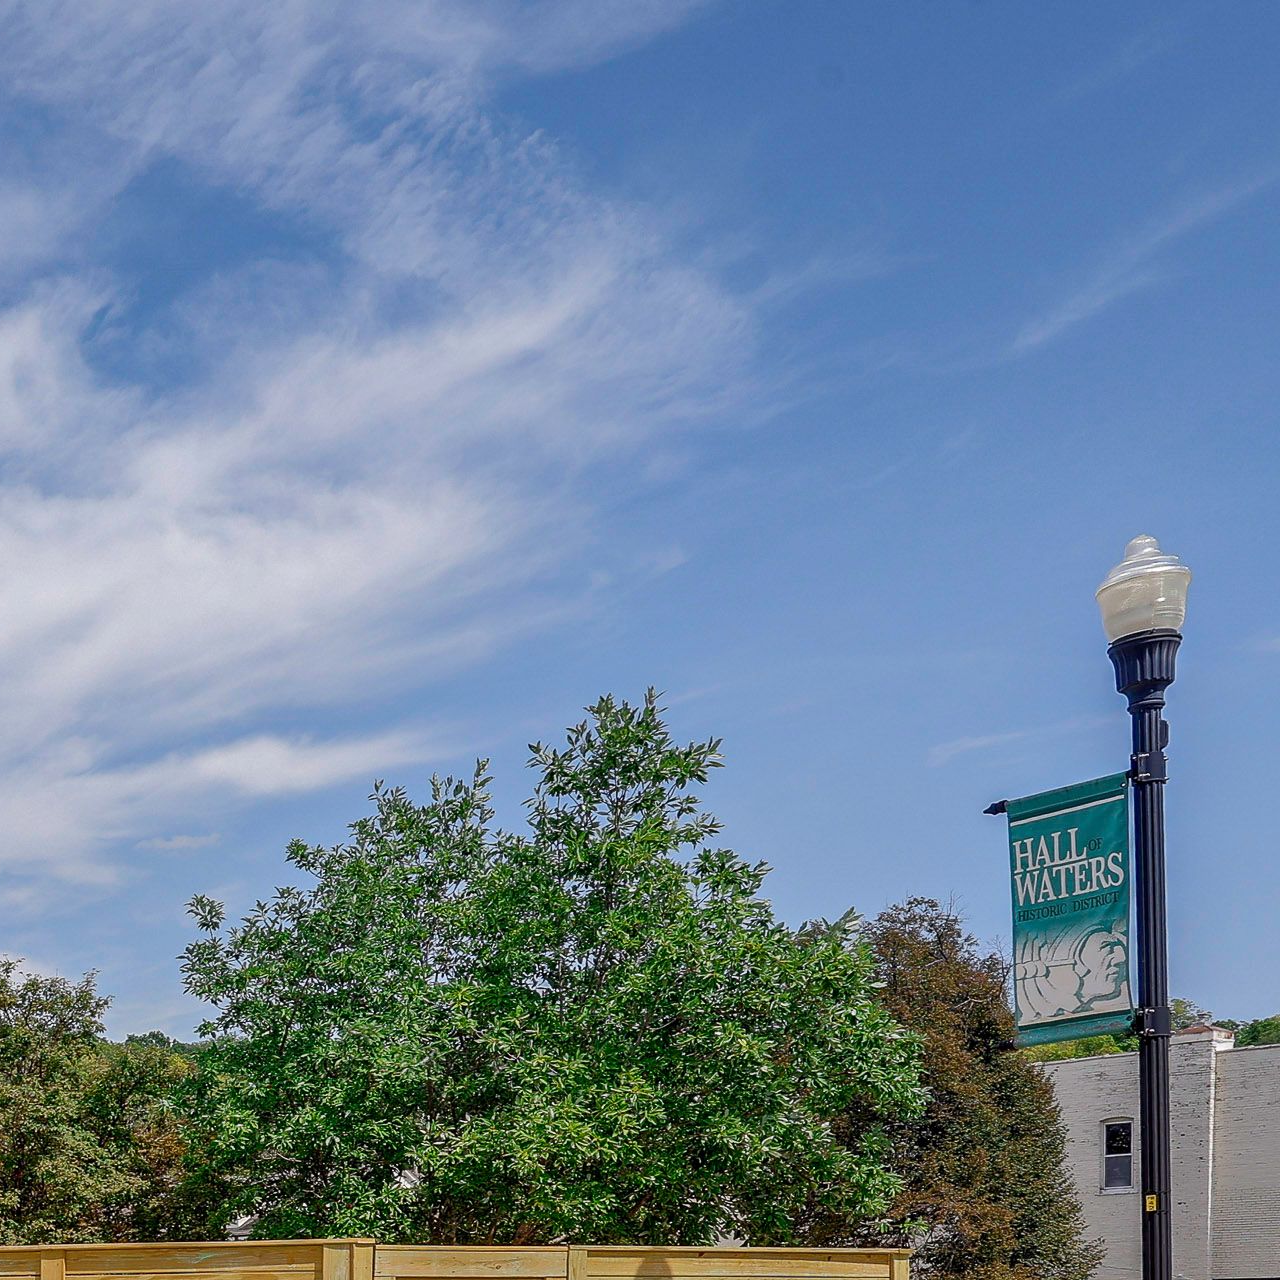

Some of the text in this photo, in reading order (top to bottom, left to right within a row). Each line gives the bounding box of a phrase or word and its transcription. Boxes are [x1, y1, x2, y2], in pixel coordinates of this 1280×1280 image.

[1012, 828, 1103, 874] HALL OF
[1014, 852, 1124, 907] WATERS
[1017, 891, 1120, 921] HISTORIC DISTRICT
